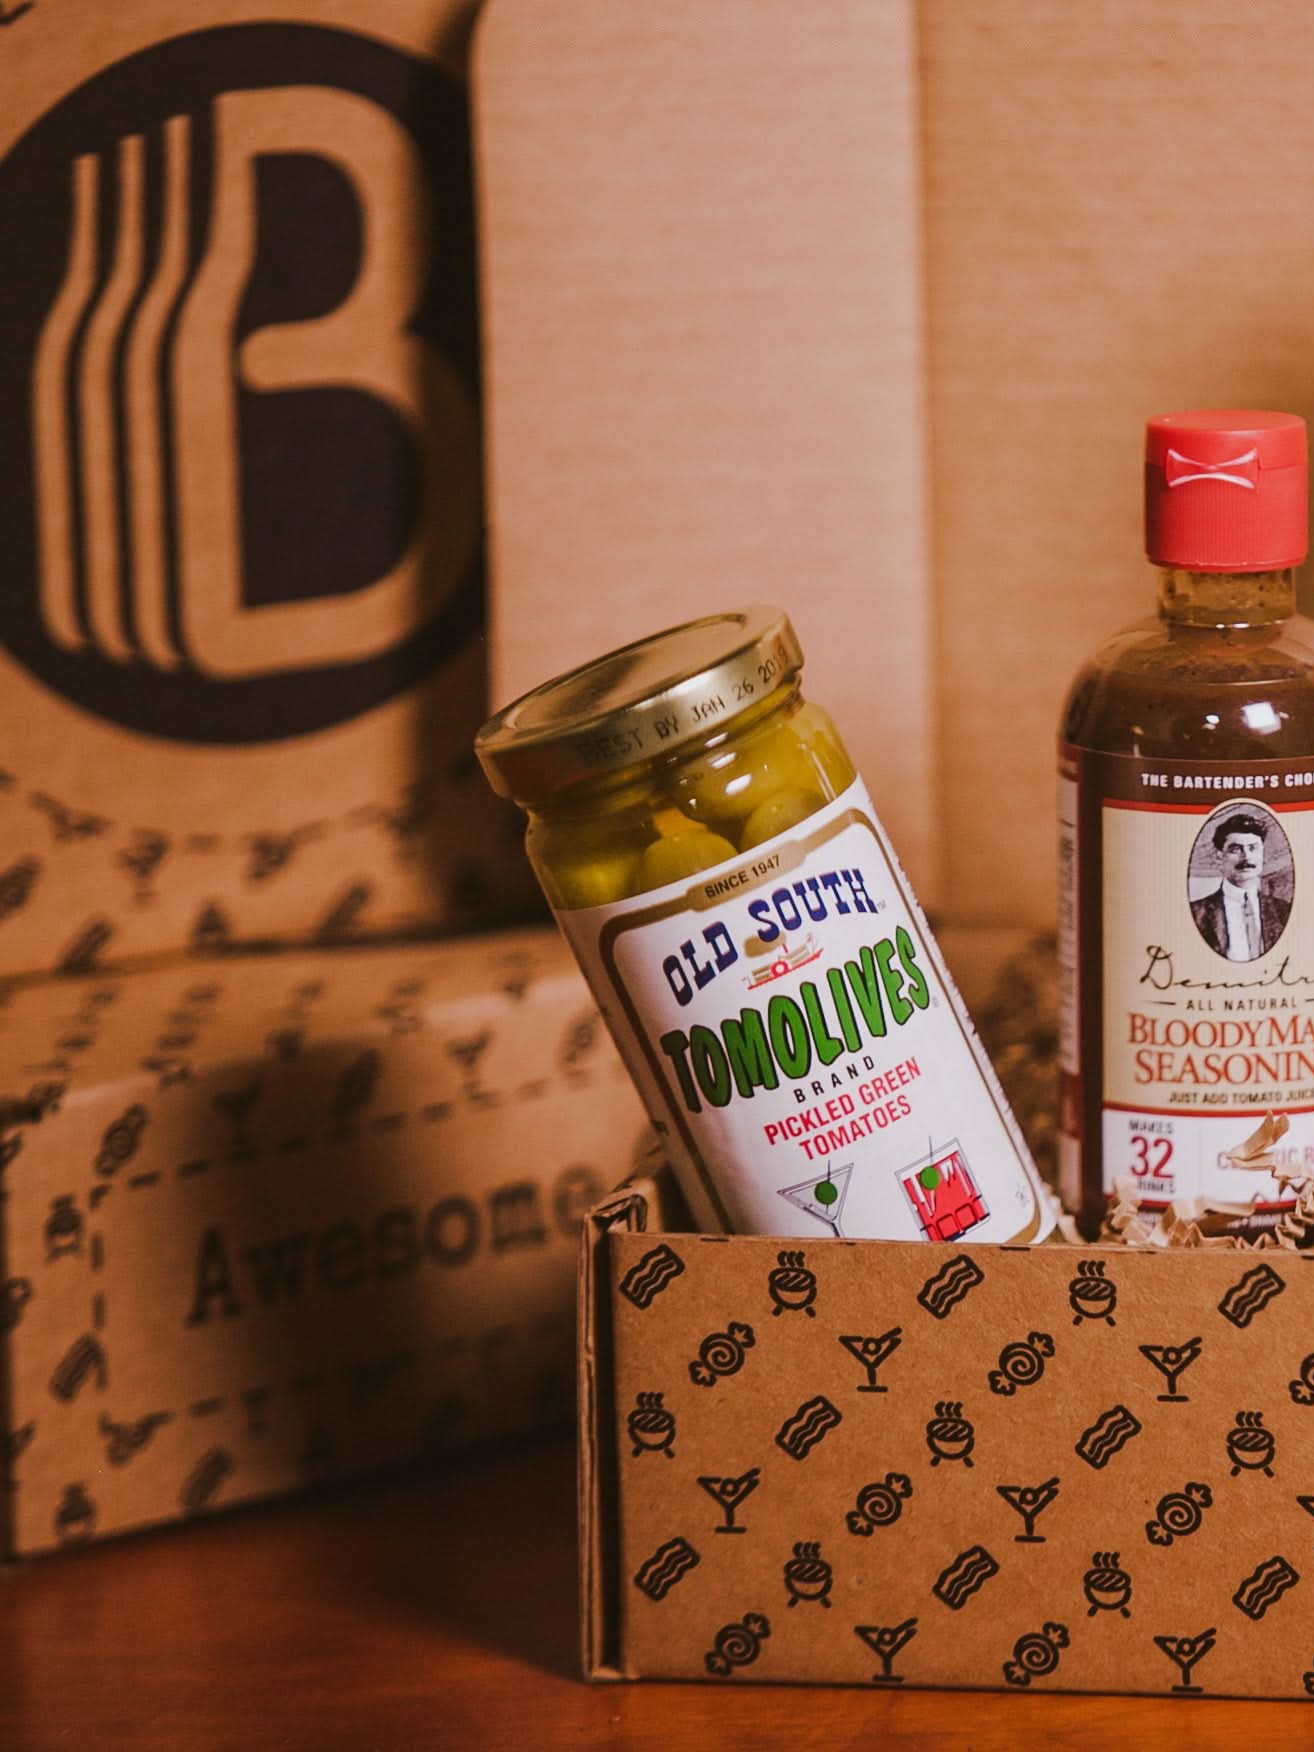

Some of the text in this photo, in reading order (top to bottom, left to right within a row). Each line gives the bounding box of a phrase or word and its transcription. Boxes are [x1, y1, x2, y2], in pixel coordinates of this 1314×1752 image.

[653, 715, 680, 740] BY
[690, 695, 726, 723] JAN
[734, 681, 755, 700] 26
[1141, 773, 1168, 787] THE
[1173, 775, 1279, 789] BARTENDER'S
[705, 854, 781, 898] SINCE 1947
[663, 868, 879, 1006] OLD SOUTH
[659, 925, 930, 1113] TOMOLIVES
[1186, 998, 1298, 1011] ALL NATURAL
[1126, 1012, 1264, 1049] BLOODY
[763, 1056, 922, 1146] PICKLED GREEN
[793, 1055, 875, 1104] BRAND
[1168, 1092, 1198, 1104] JUST
[1202, 1092, 1229, 1104] ADD
[1232, 1090, 1282, 1104] TOMATO
[799, 1094, 912, 1161] TOMATOES
[1130, 1135, 1175, 1178] 32
[186, 1167, 604, 1328] Awesome
